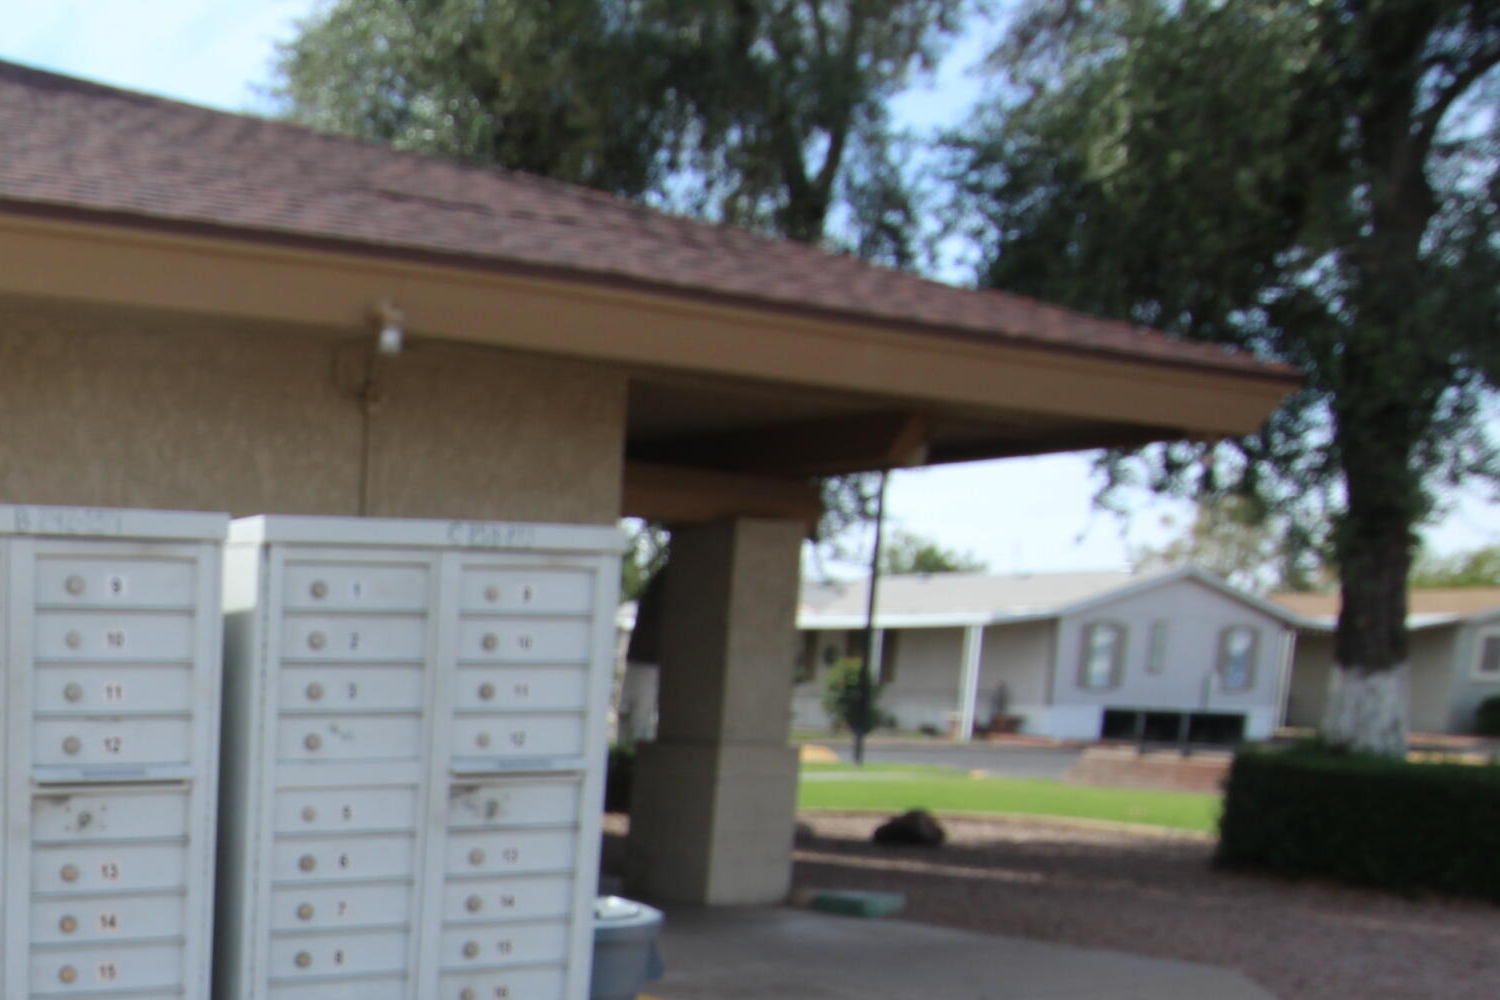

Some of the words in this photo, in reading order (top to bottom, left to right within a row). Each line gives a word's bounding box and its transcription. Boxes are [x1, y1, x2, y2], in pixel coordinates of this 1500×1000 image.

[107, 632, 125, 647] 10
[105, 685, 123, 701] 11
[103, 737, 121, 753] 12
[101, 864, 119, 879] 13
[99, 915, 117, 930] 14
[98, 965, 116, 980] 15
